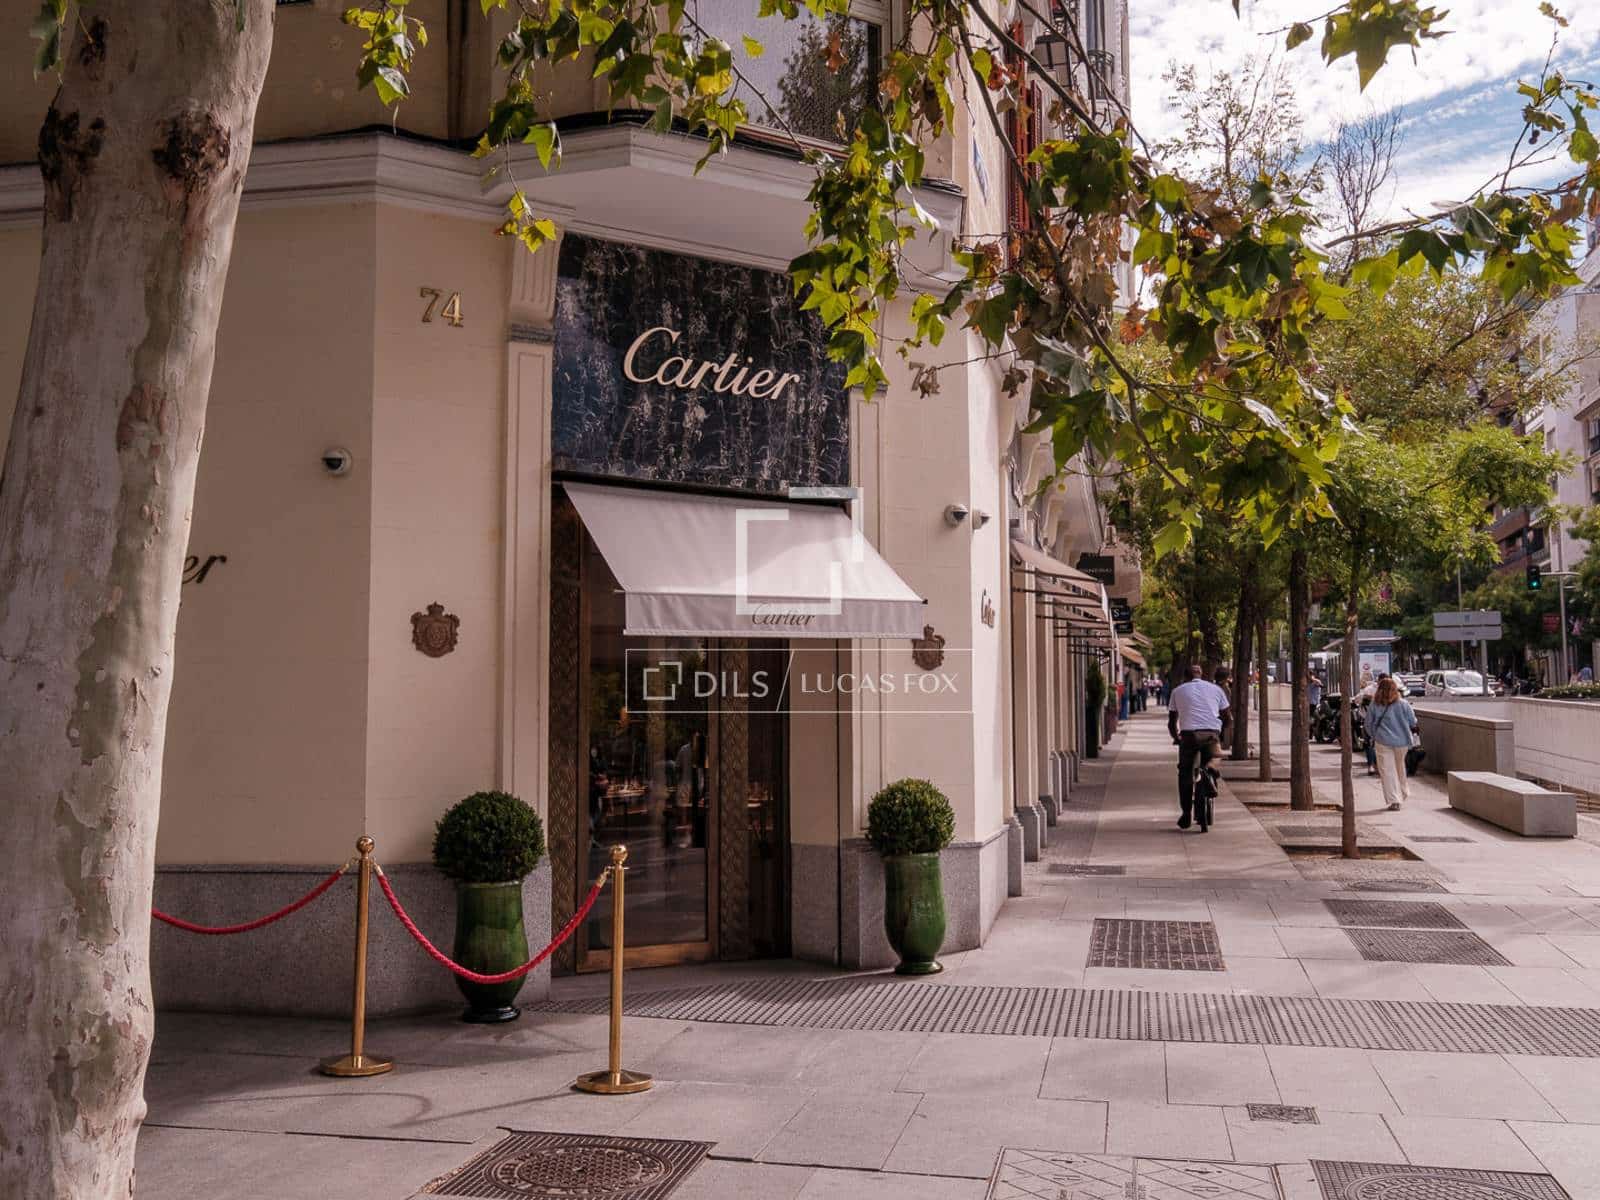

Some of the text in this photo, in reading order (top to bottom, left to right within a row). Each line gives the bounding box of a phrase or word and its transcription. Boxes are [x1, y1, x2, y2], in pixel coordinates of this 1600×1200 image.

[420, 287, 464, 328] 74
[623, 326, 801, 400] Cartier
[751, 602, 816, 625] Cartier
